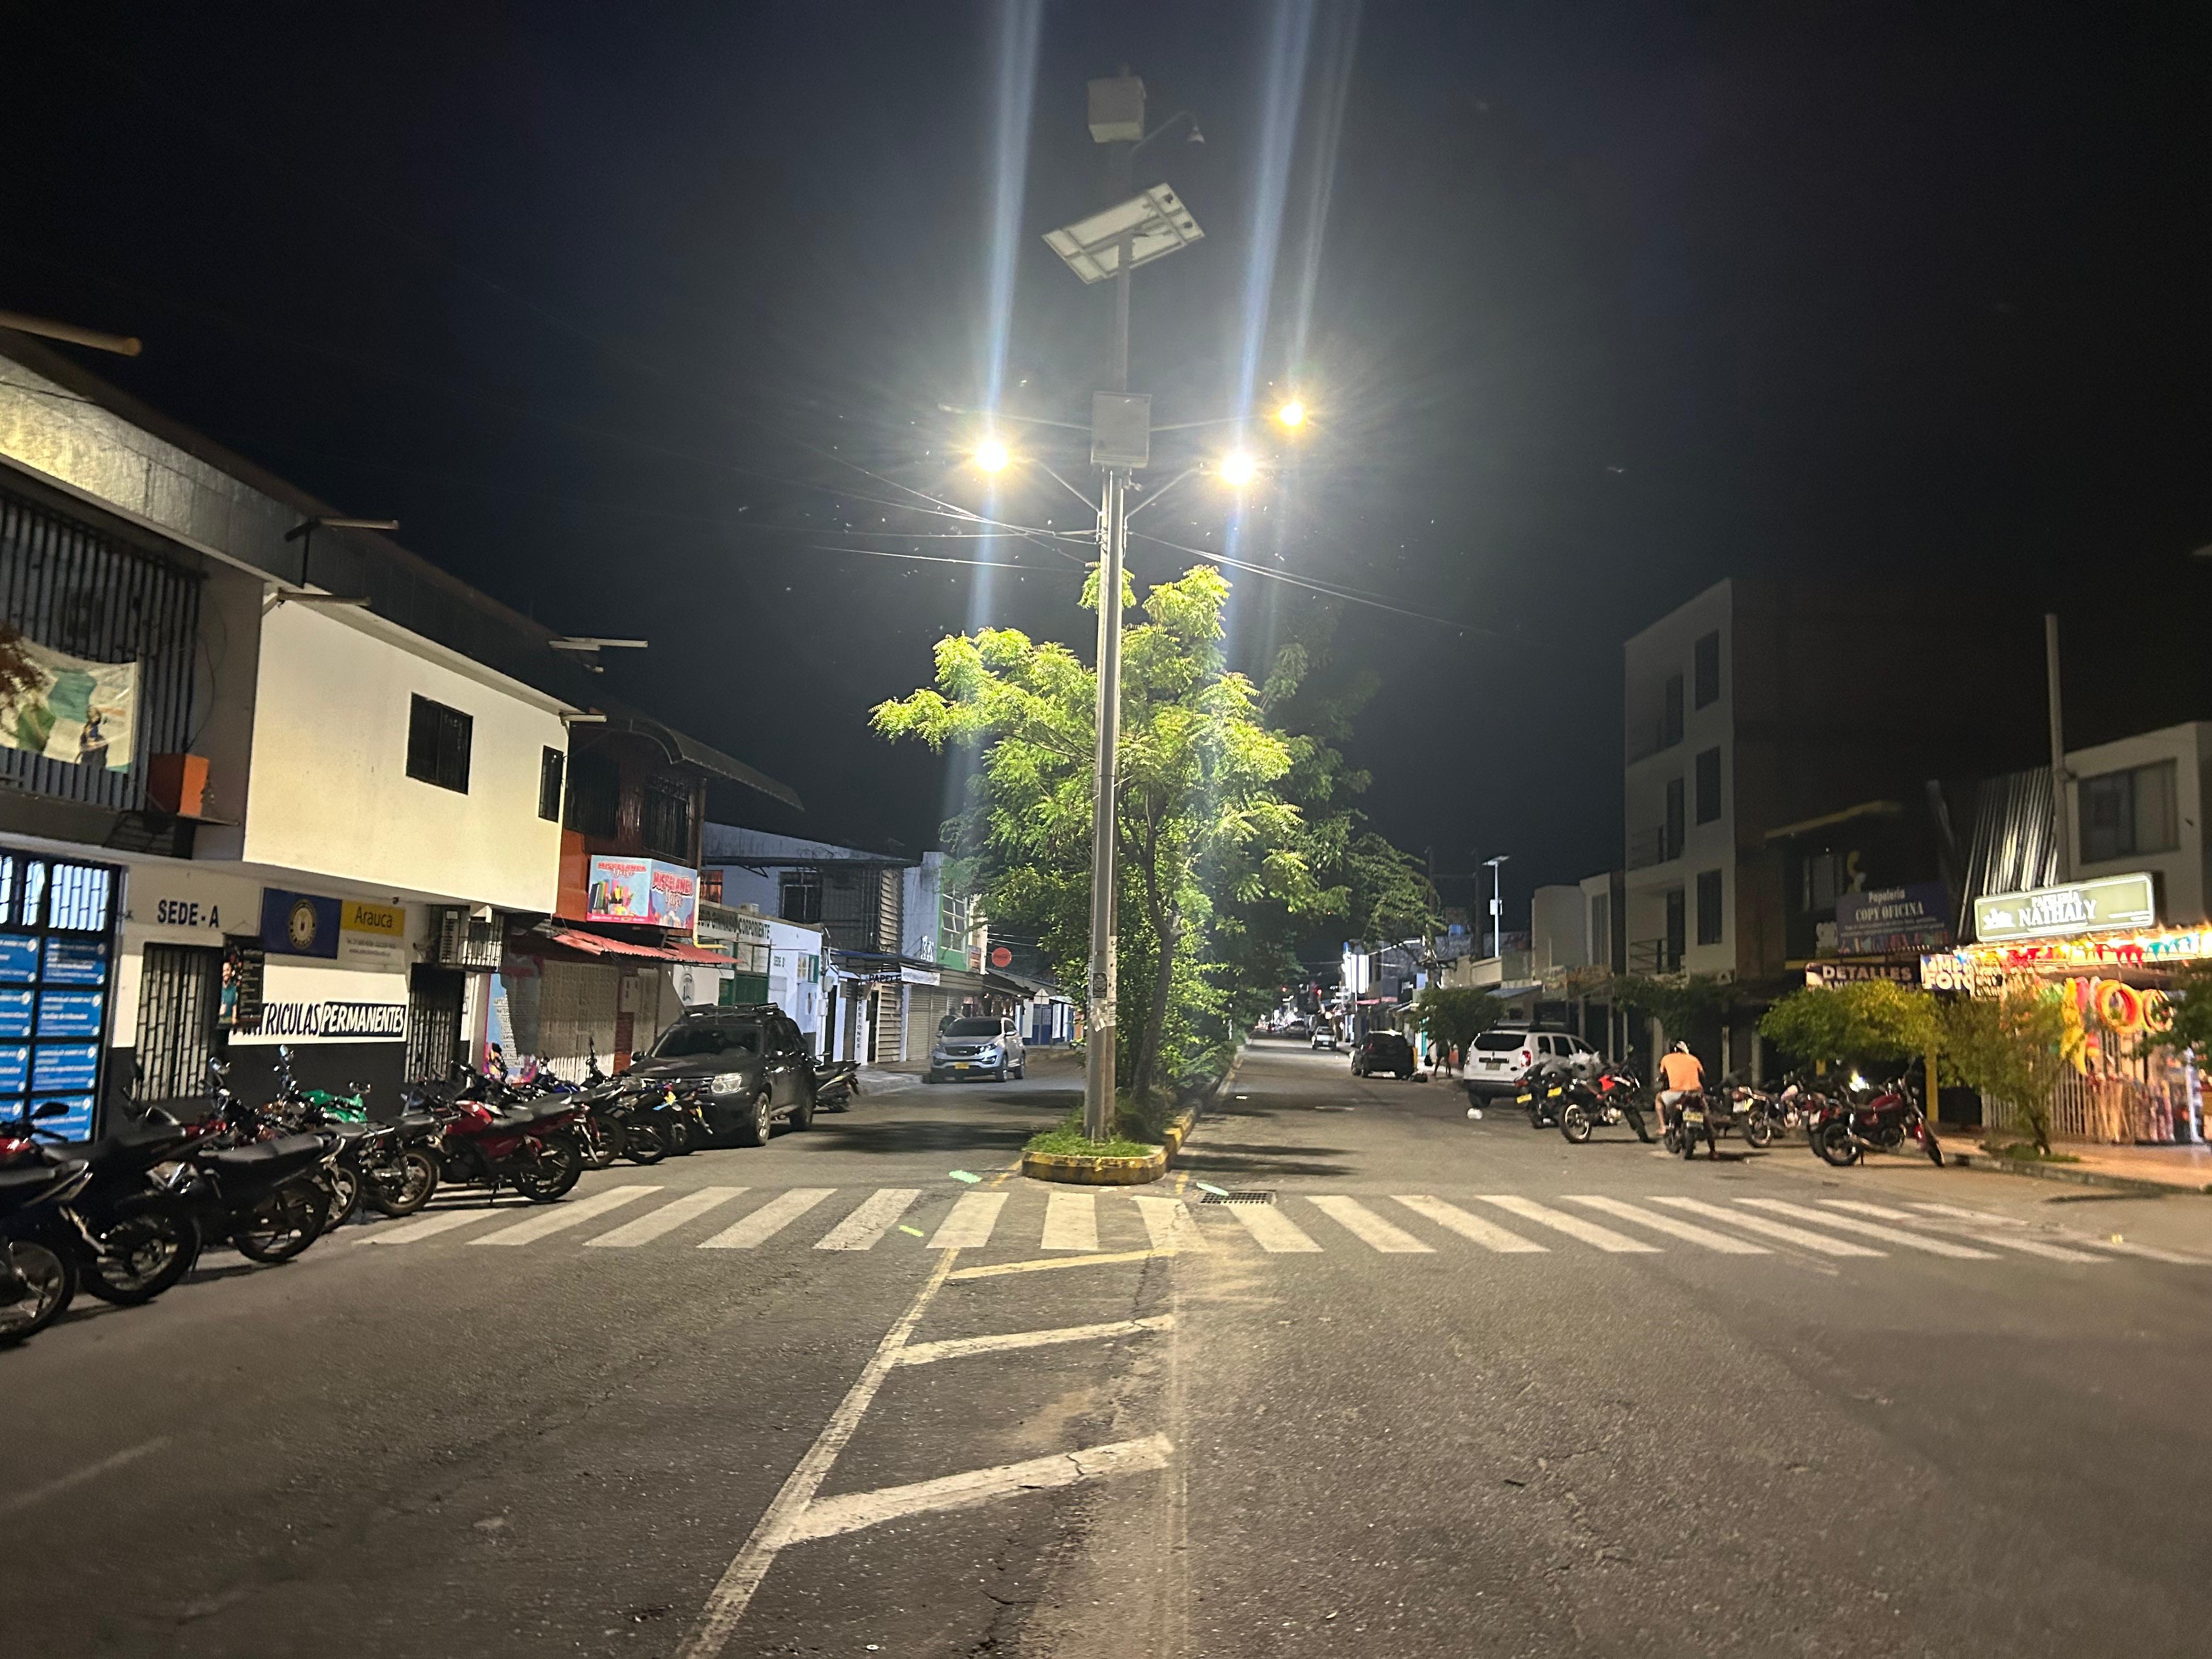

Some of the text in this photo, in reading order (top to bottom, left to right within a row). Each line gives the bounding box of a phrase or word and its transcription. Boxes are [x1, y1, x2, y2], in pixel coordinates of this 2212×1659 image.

[354, 906, 393, 928] Arauca
[2018, 899, 2098, 927] NATHALY
[1821, 964, 1913, 981] DETALLES
[320, 1004, 405, 1034] PERMANENTES
